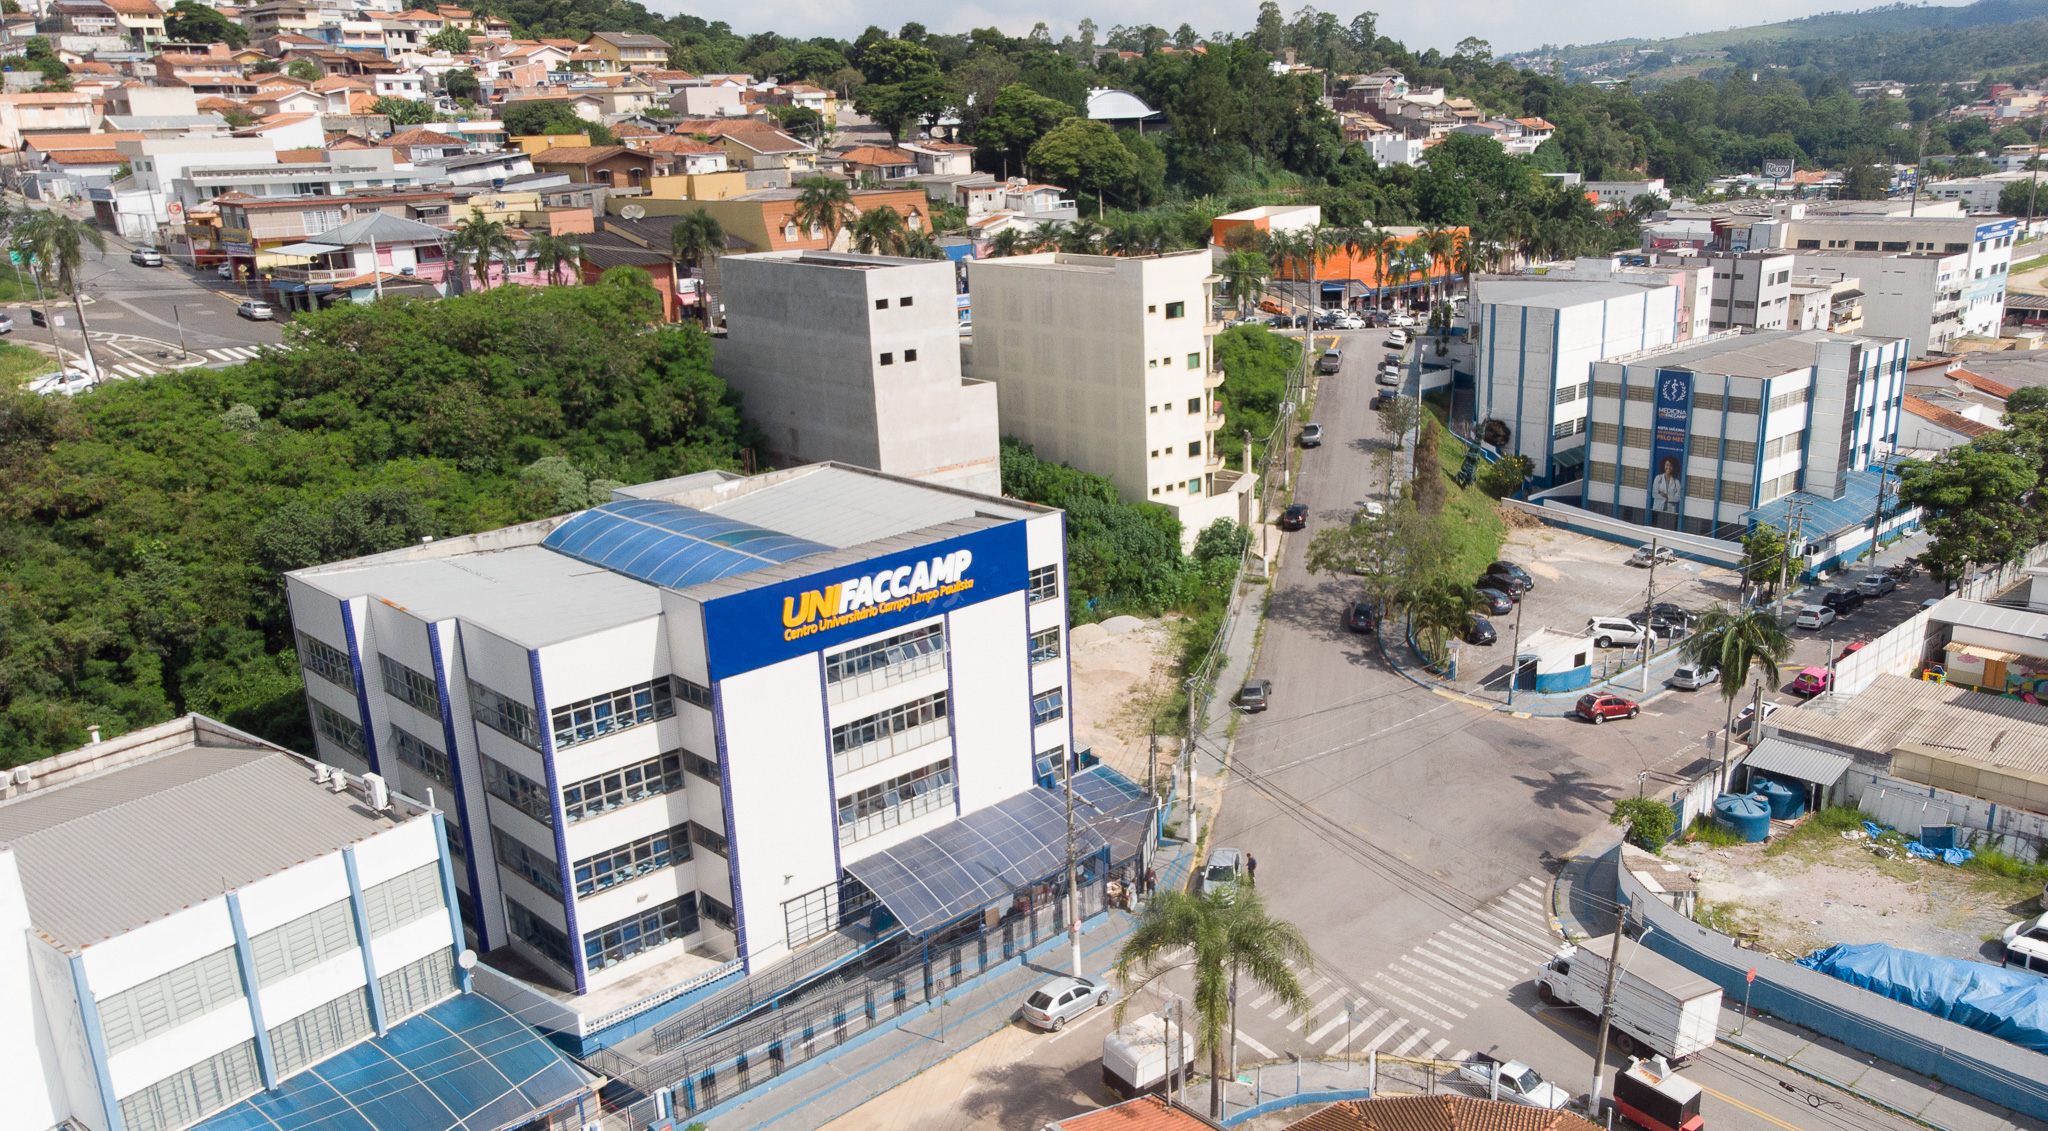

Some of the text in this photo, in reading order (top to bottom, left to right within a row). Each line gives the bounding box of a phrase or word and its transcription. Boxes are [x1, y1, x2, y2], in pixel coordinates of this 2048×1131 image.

[1766, 163, 1789, 177] Ricoy
[1658, 407, 1687, 415] MEDICINA
[782, 549, 973, 628] UNIFACCAMP
[784, 579, 974, 642] Centro Universitário Campo Limpo Paulista
